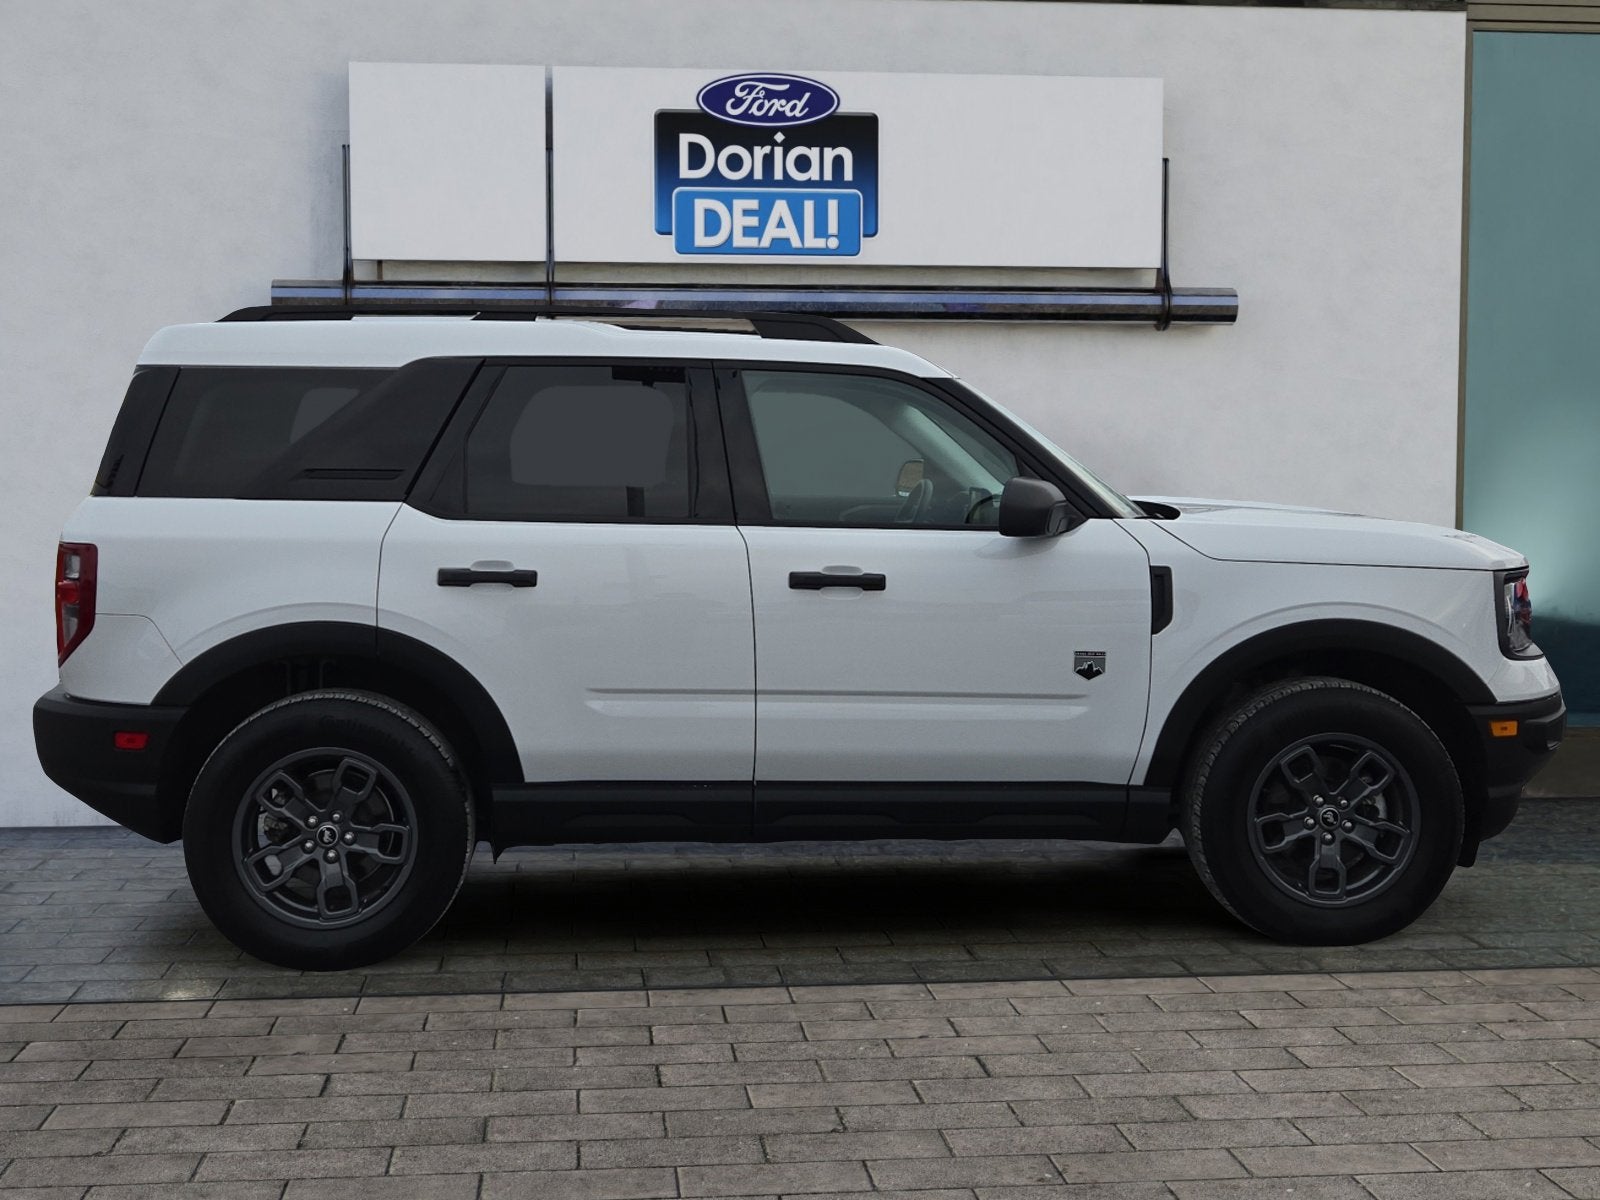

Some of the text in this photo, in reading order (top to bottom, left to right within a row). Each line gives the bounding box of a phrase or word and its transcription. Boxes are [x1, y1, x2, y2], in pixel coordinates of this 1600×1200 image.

[725, 81, 811, 118] Ford
[678, 131, 854, 182] Dorian
[694, 198, 840, 250] DEAL!
